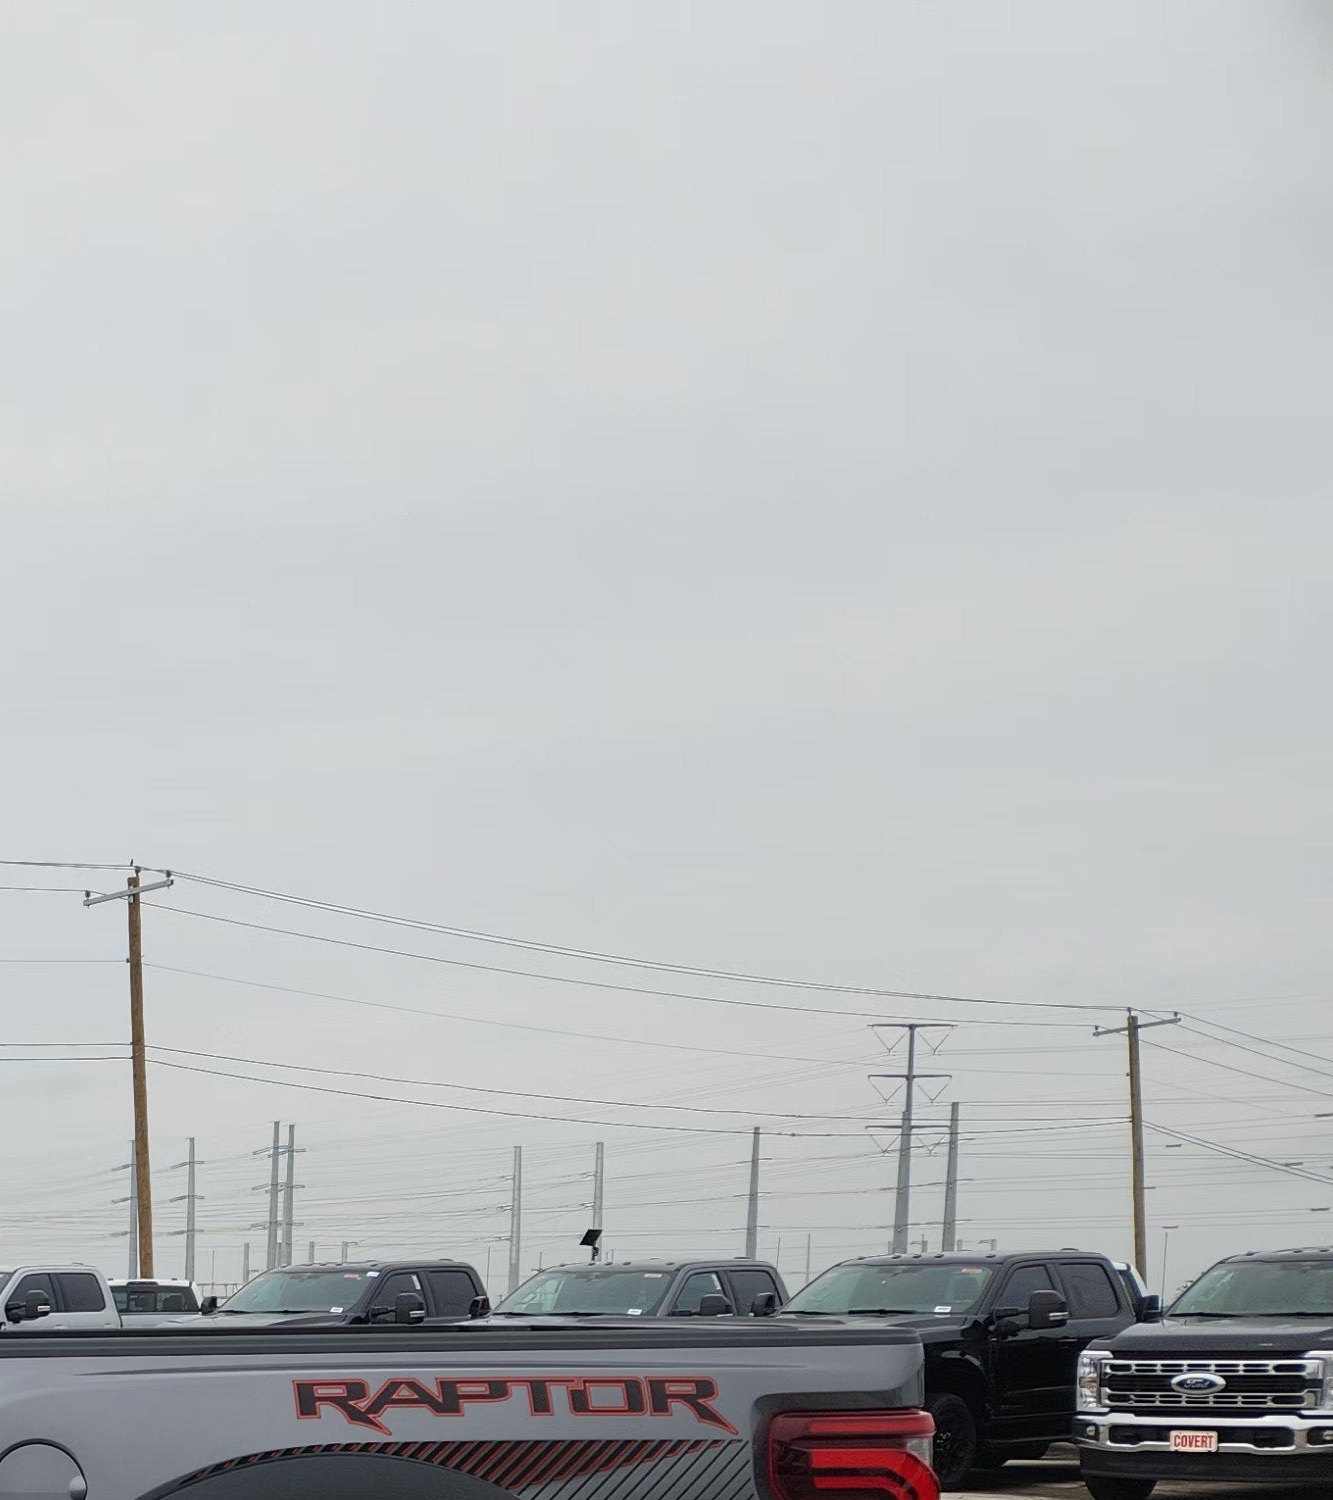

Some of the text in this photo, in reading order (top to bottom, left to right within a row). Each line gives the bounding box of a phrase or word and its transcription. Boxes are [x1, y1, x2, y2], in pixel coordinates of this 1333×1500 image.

[1183, 1378, 1211, 1389] Ford
[292, 1376, 739, 1436] RAPTOR
[1173, 1434, 1215, 1449] COVERT
